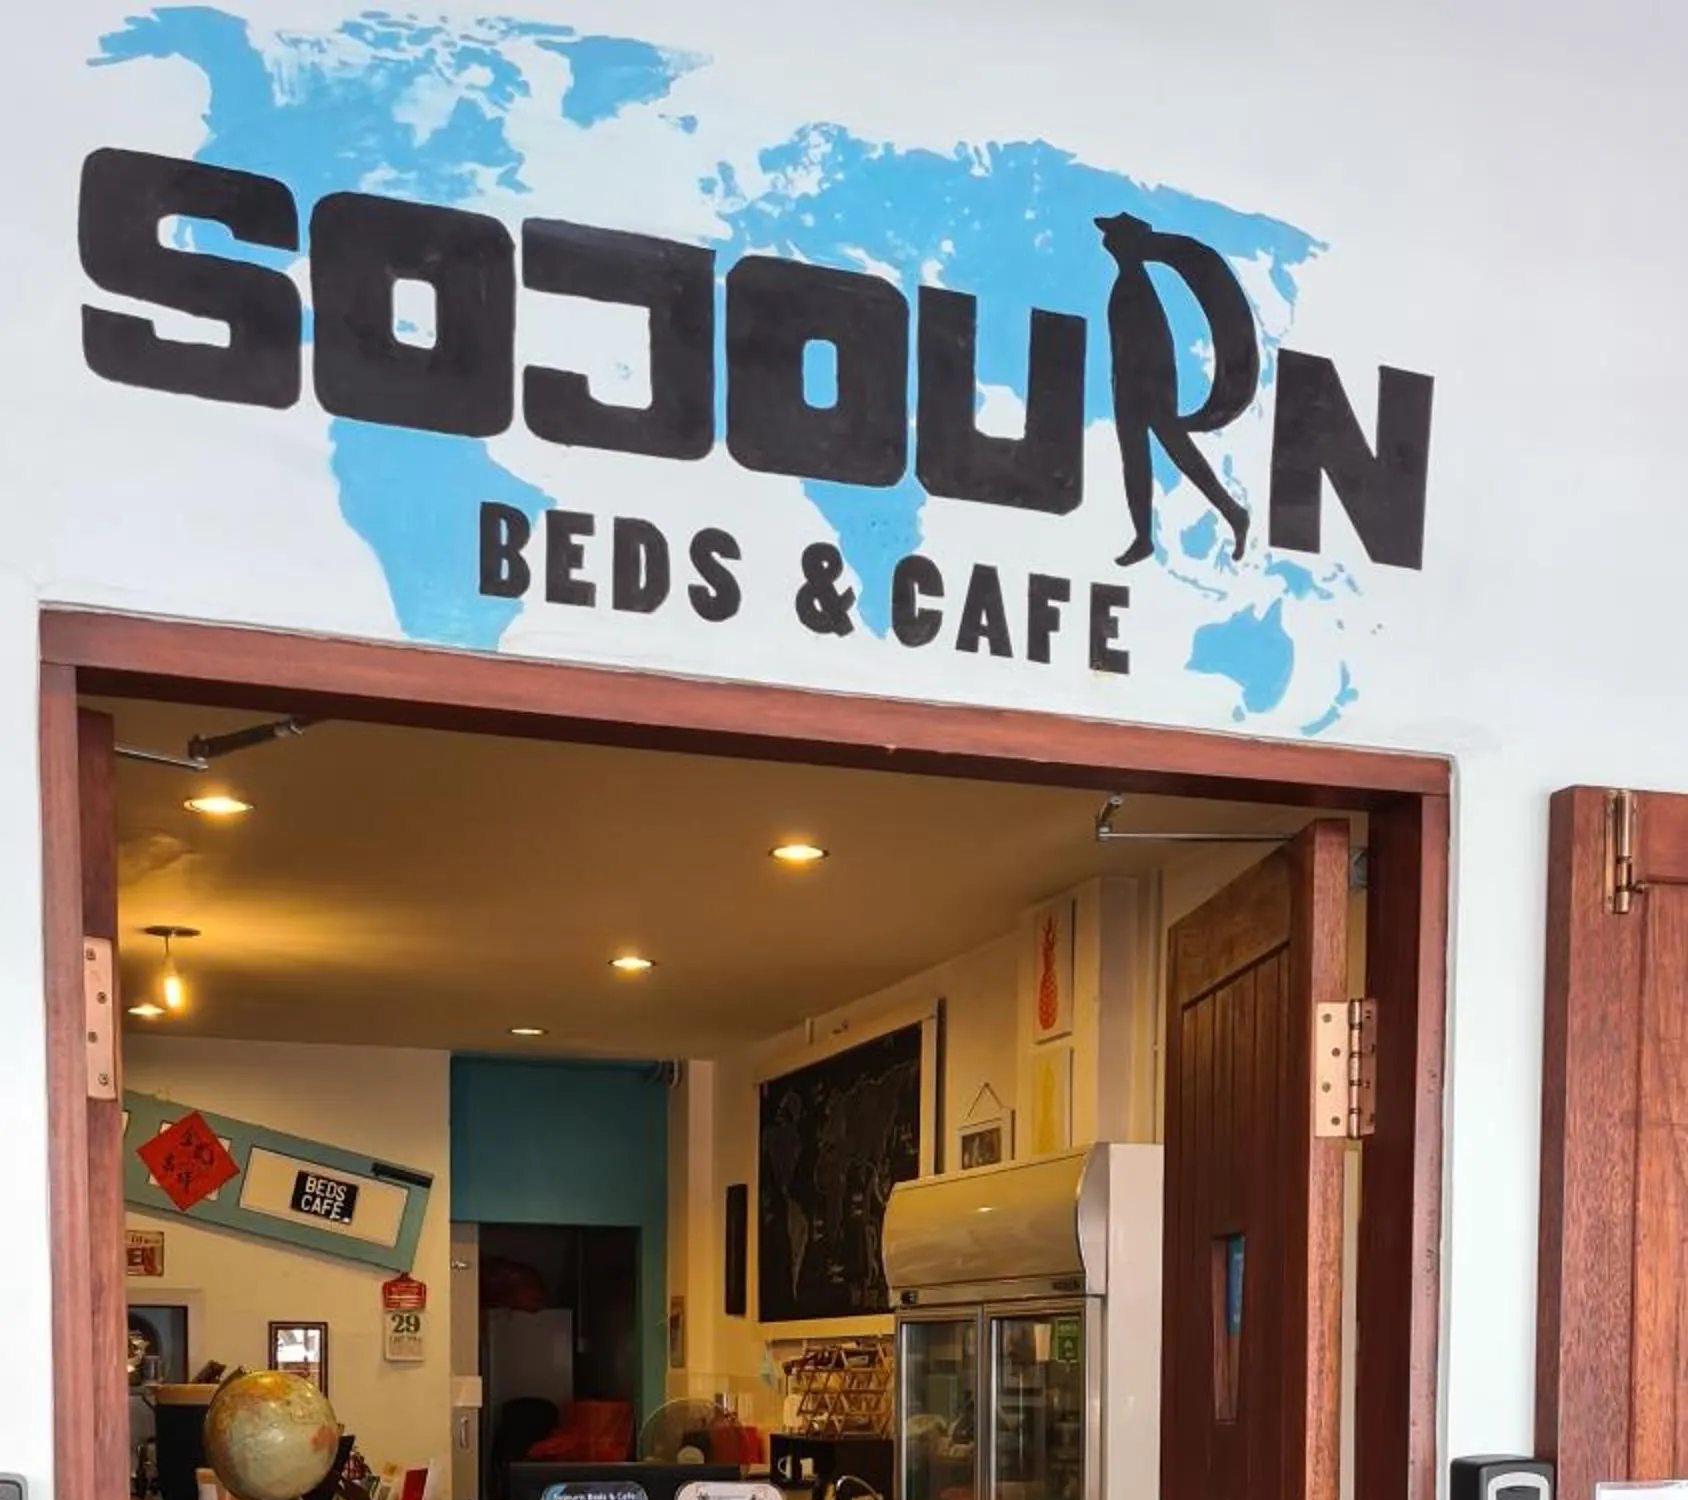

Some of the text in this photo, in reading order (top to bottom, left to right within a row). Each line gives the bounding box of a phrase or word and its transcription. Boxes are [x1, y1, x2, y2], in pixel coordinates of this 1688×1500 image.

[78, 147, 1434, 570] SOJOURN
[479, 501, 1130, 674] BEDS & CAFE
[305, 1175, 347, 1201] BEDS
[391, 1313, 421, 1334] 29
